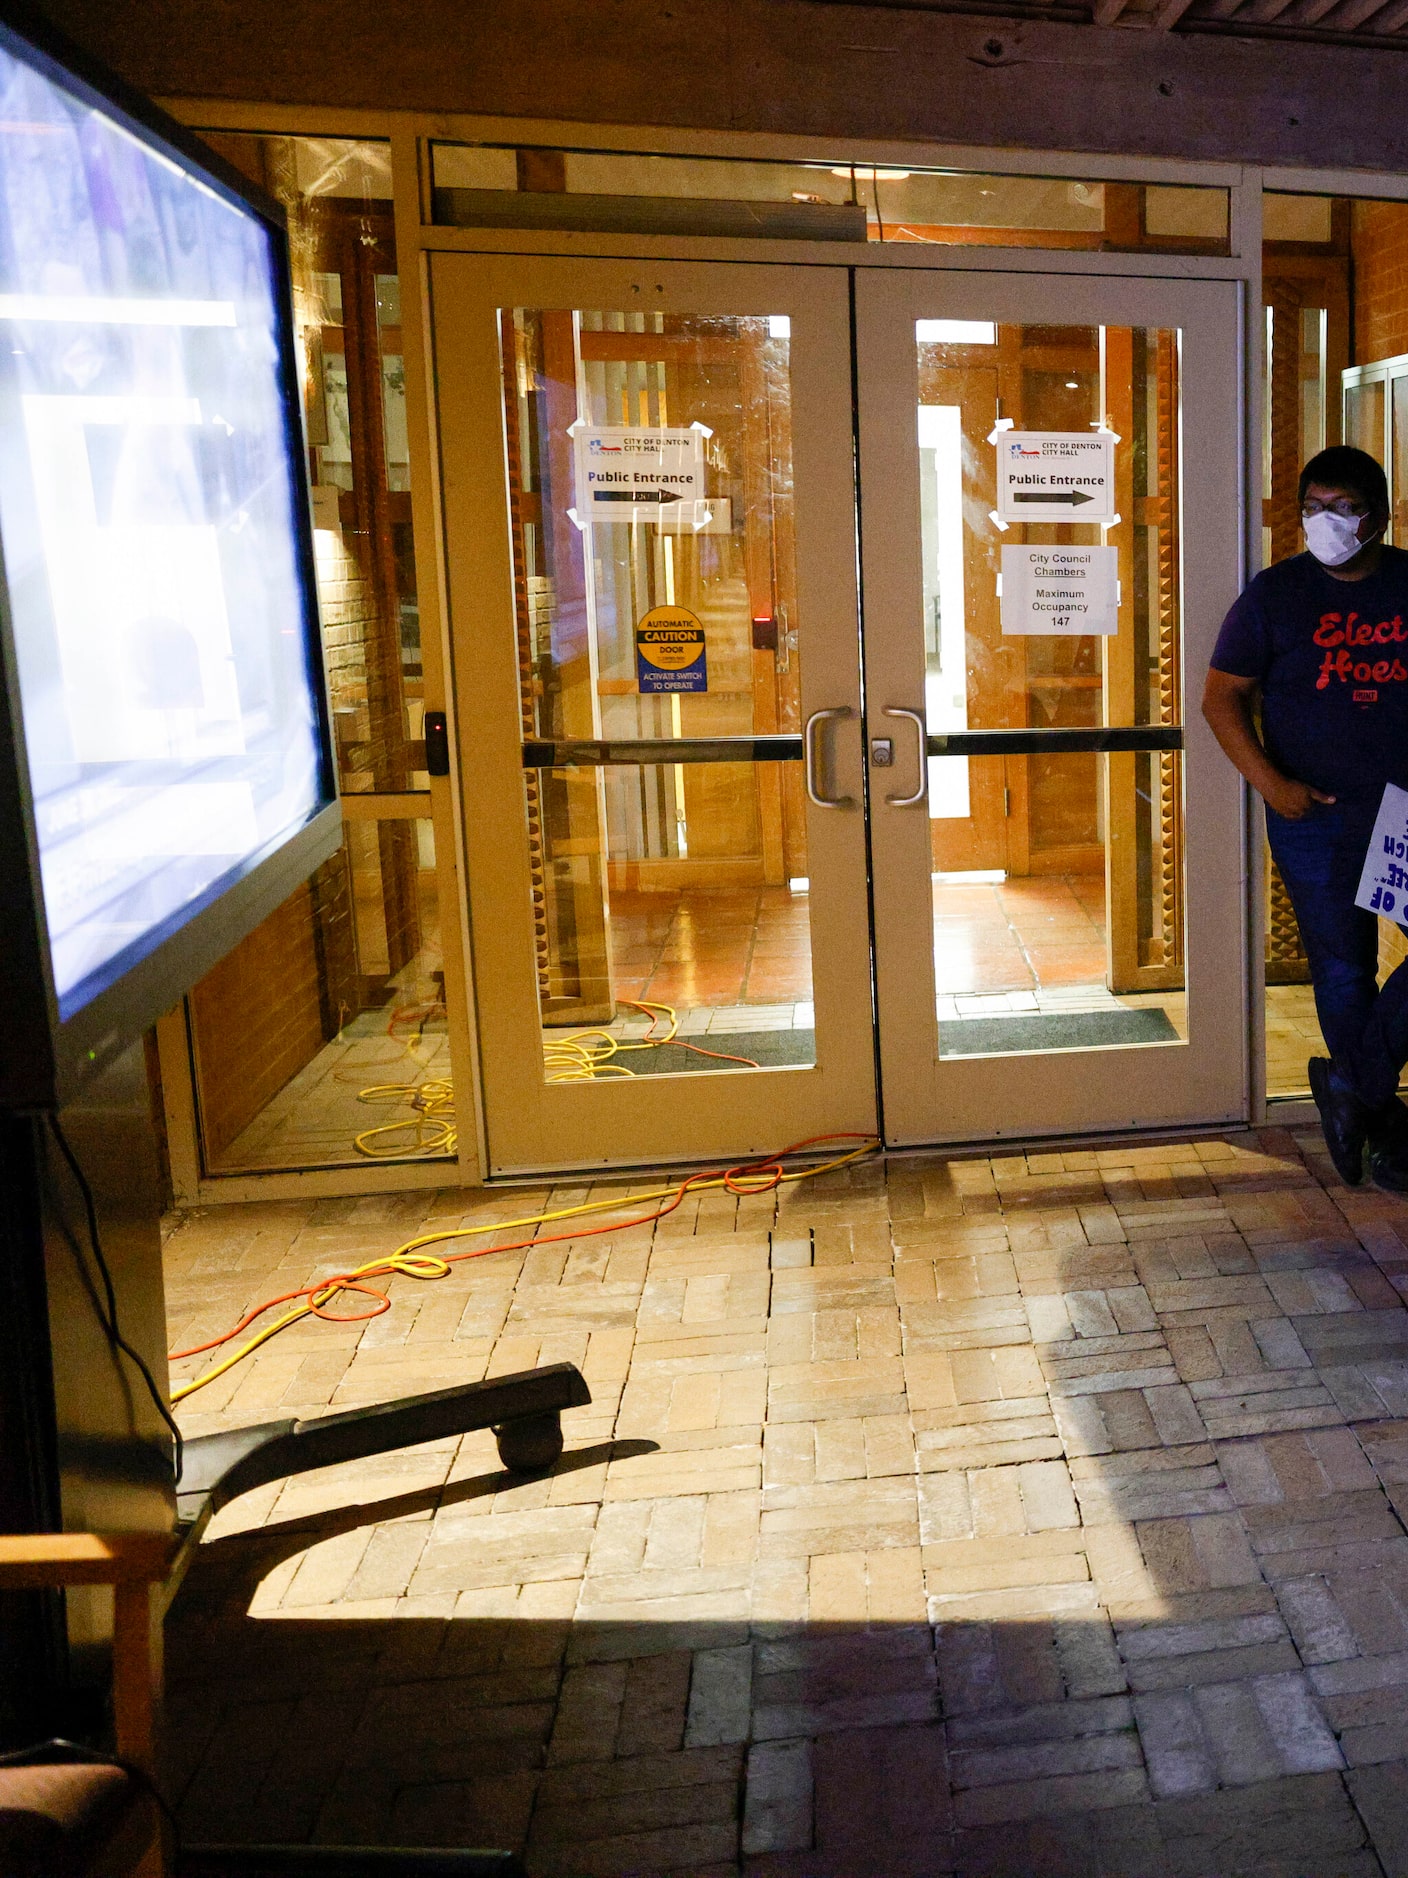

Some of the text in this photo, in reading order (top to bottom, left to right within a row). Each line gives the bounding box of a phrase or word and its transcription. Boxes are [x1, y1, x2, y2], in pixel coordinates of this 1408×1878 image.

[588, 472, 693, 483] Public Entrance
[1009, 474, 1105, 486] Public Entrance
[1029, 554, 1091, 564] City Council
[1034, 567, 1086, 577] Chambers
[1036, 589, 1085, 598] Maximum
[1032, 602, 1088, 613] Occupancy
[1051, 617, 1070, 626] 147
[1312, 612, 1408, 648] Elect
[644, 631, 697, 641] CAUTION
[1316, 649, 1408, 690] Hoes
[643, 672, 702, 681] ACTIVATE SWITCH
[1370, 887, 1395, 912] OF
